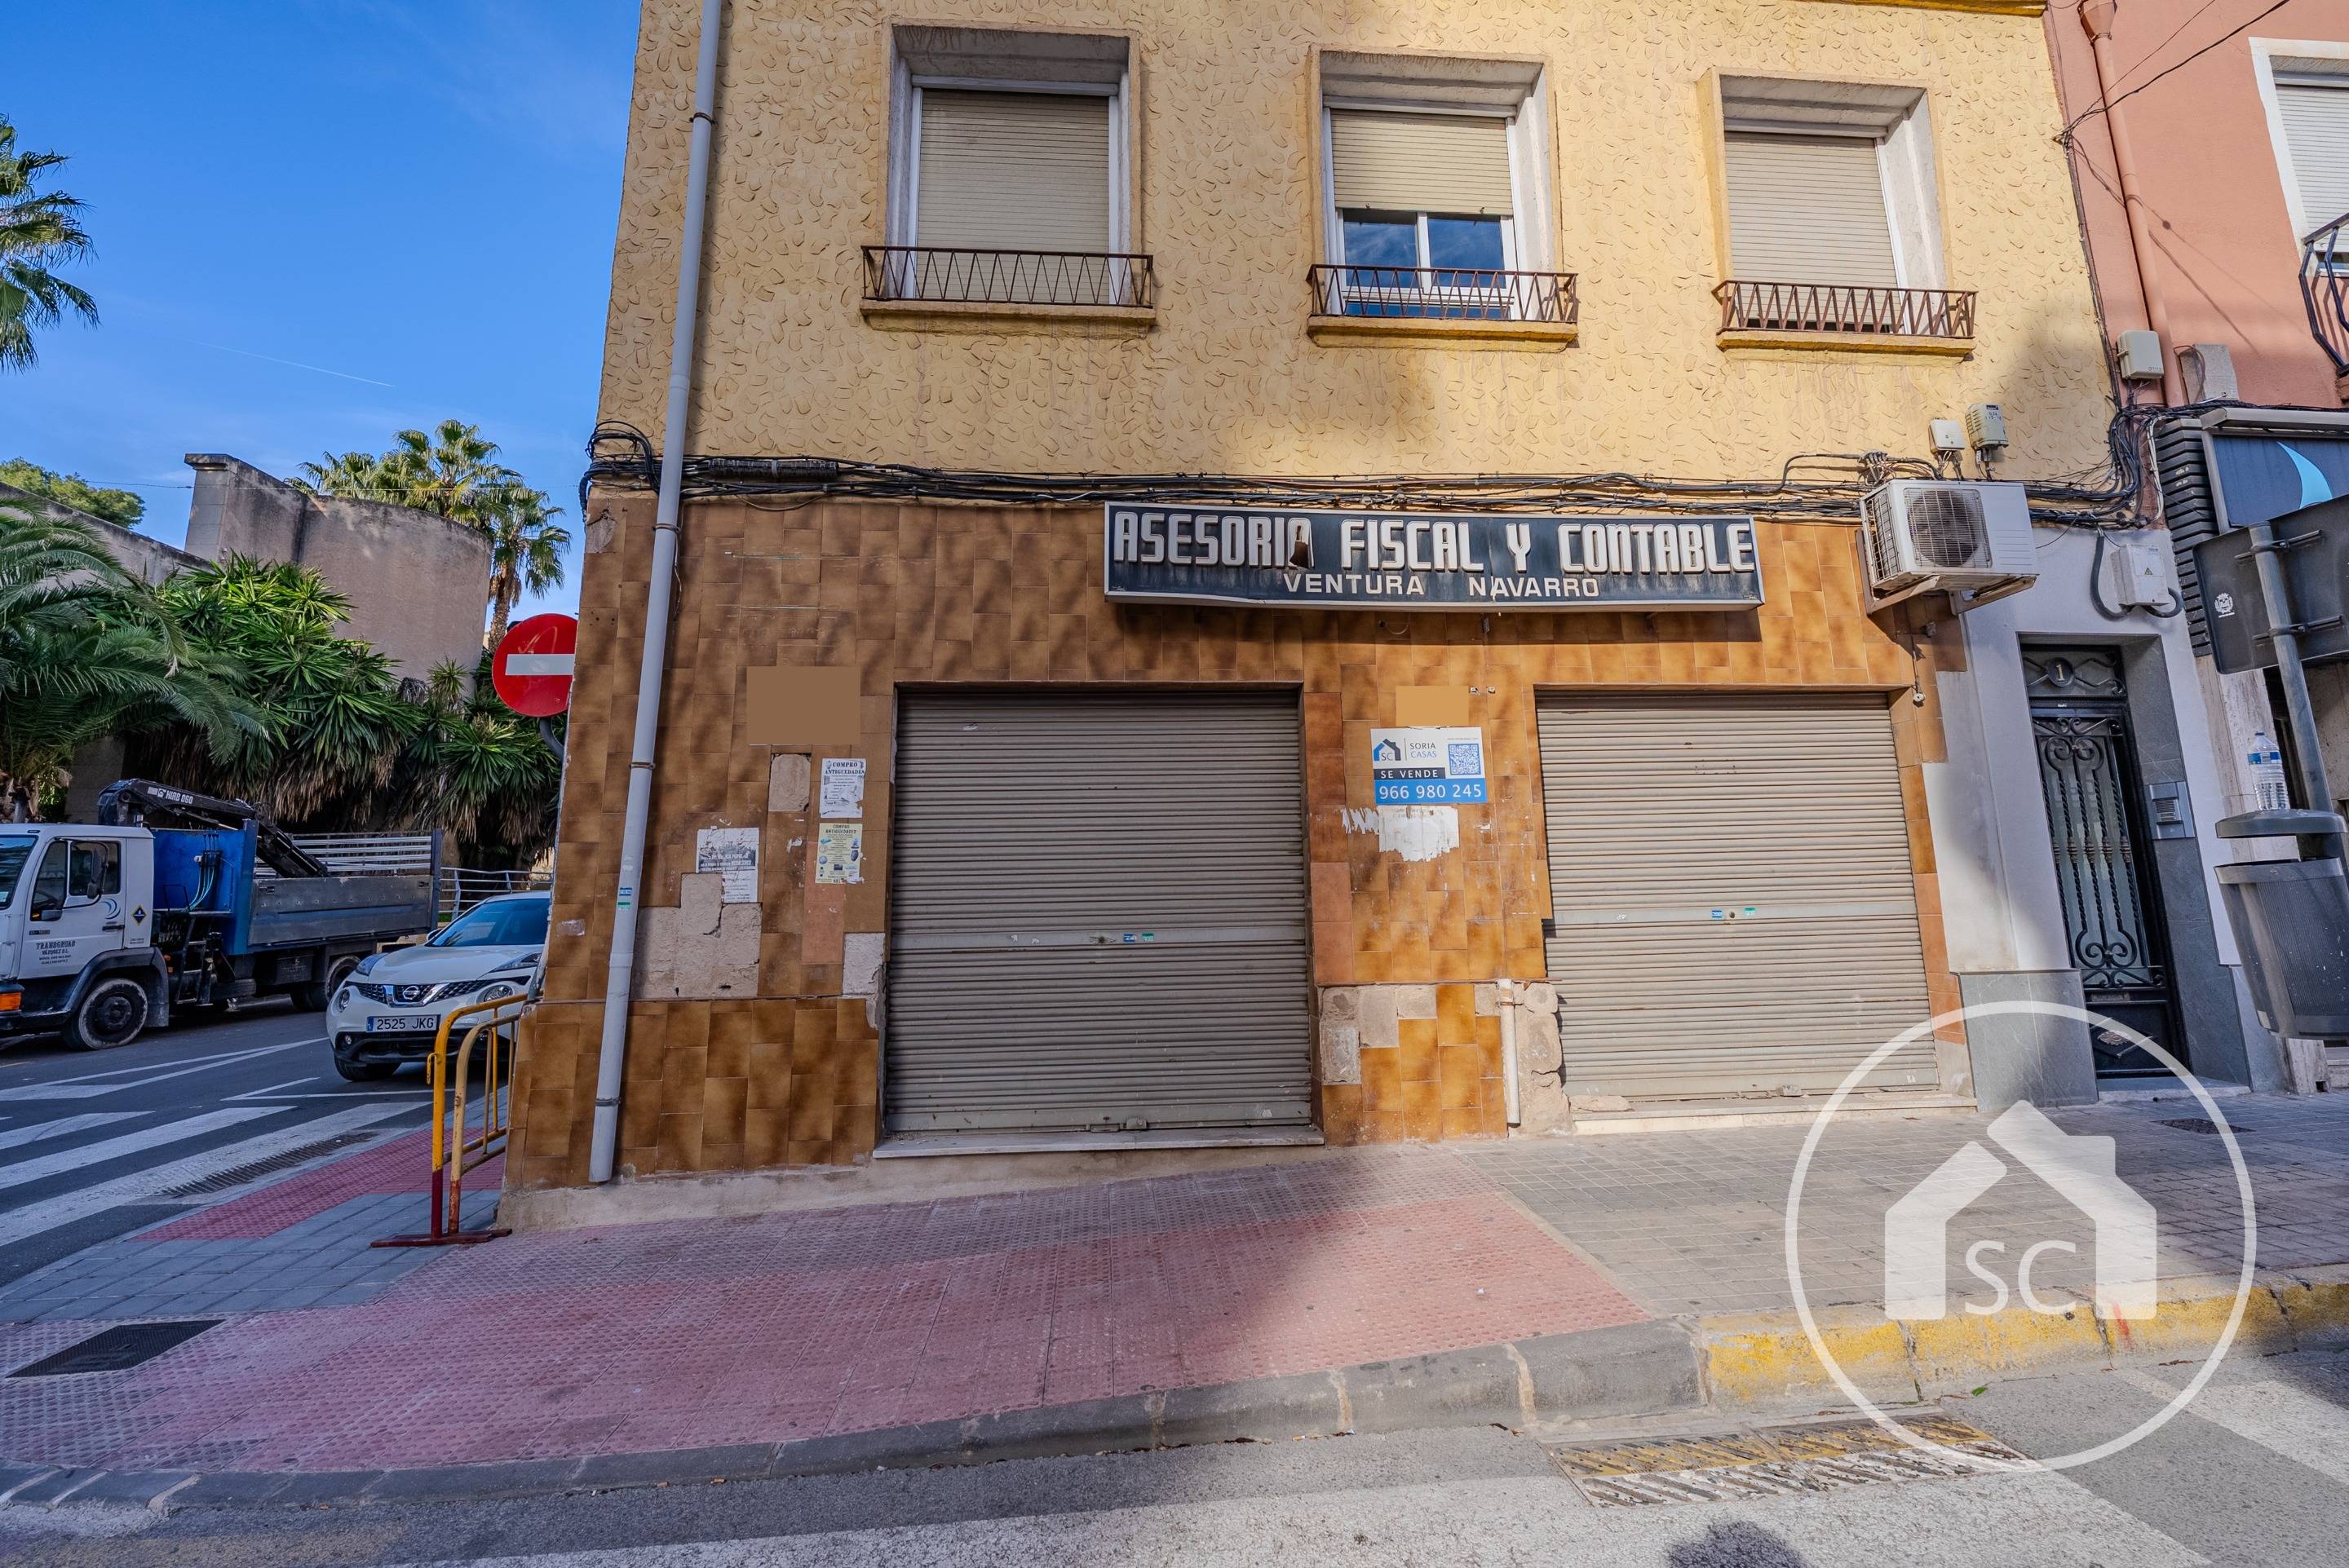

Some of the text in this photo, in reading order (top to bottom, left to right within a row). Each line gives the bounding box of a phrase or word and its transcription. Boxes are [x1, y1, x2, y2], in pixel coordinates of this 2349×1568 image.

[1114, 511, 1755, 574] ASESORIA FISCAL Y CONTABLE
[1283, 573, 1599, 598] VENTURA NAVARRO
[2056, 664, 2065, 681] 1
[1409, 742, 1436, 750] SORIA
[1381, 752, 1394, 762] SC
[1410, 750, 1437, 758] CASAS
[1380, 769, 1439, 779] SE VENDE
[1378, 784, 1482, 799] 966 980 245
[376, 1018, 435, 1031] 2525 JKG
